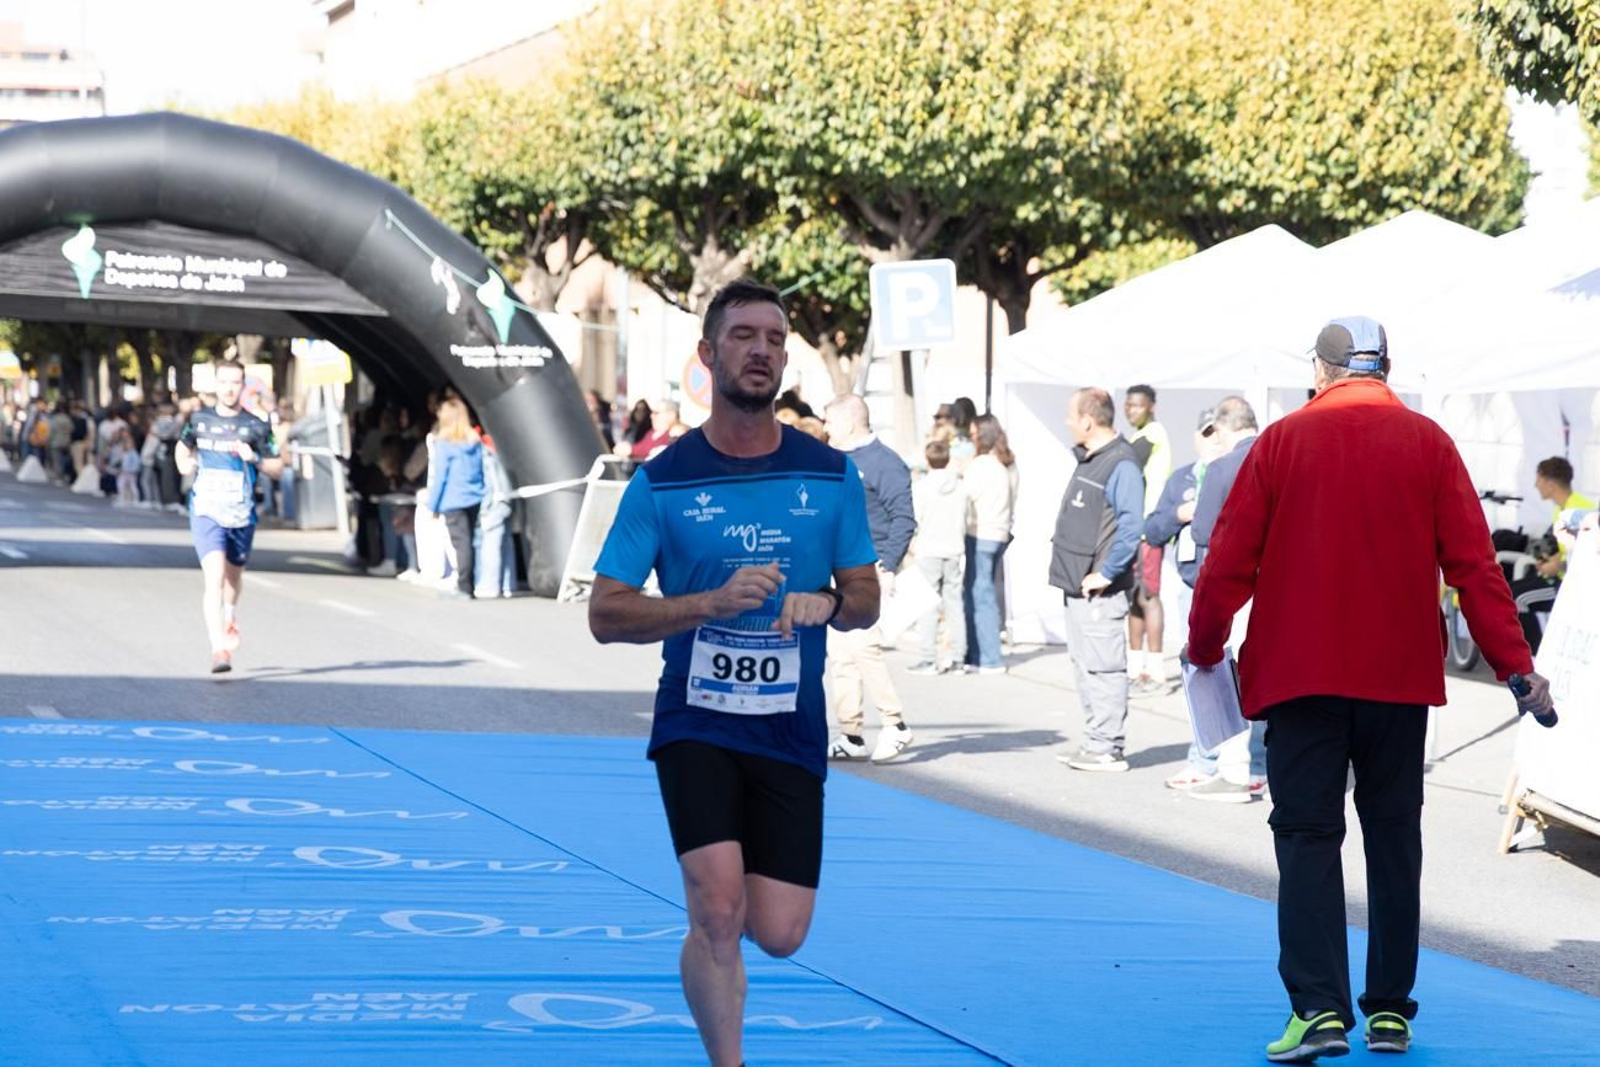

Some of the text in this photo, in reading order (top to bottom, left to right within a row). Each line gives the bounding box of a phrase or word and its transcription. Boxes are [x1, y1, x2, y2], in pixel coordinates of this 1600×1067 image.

[889, 272, 940, 340] P
[712, 653, 781, 683] 980
[234, 1013, 461, 1022] MEDIA
